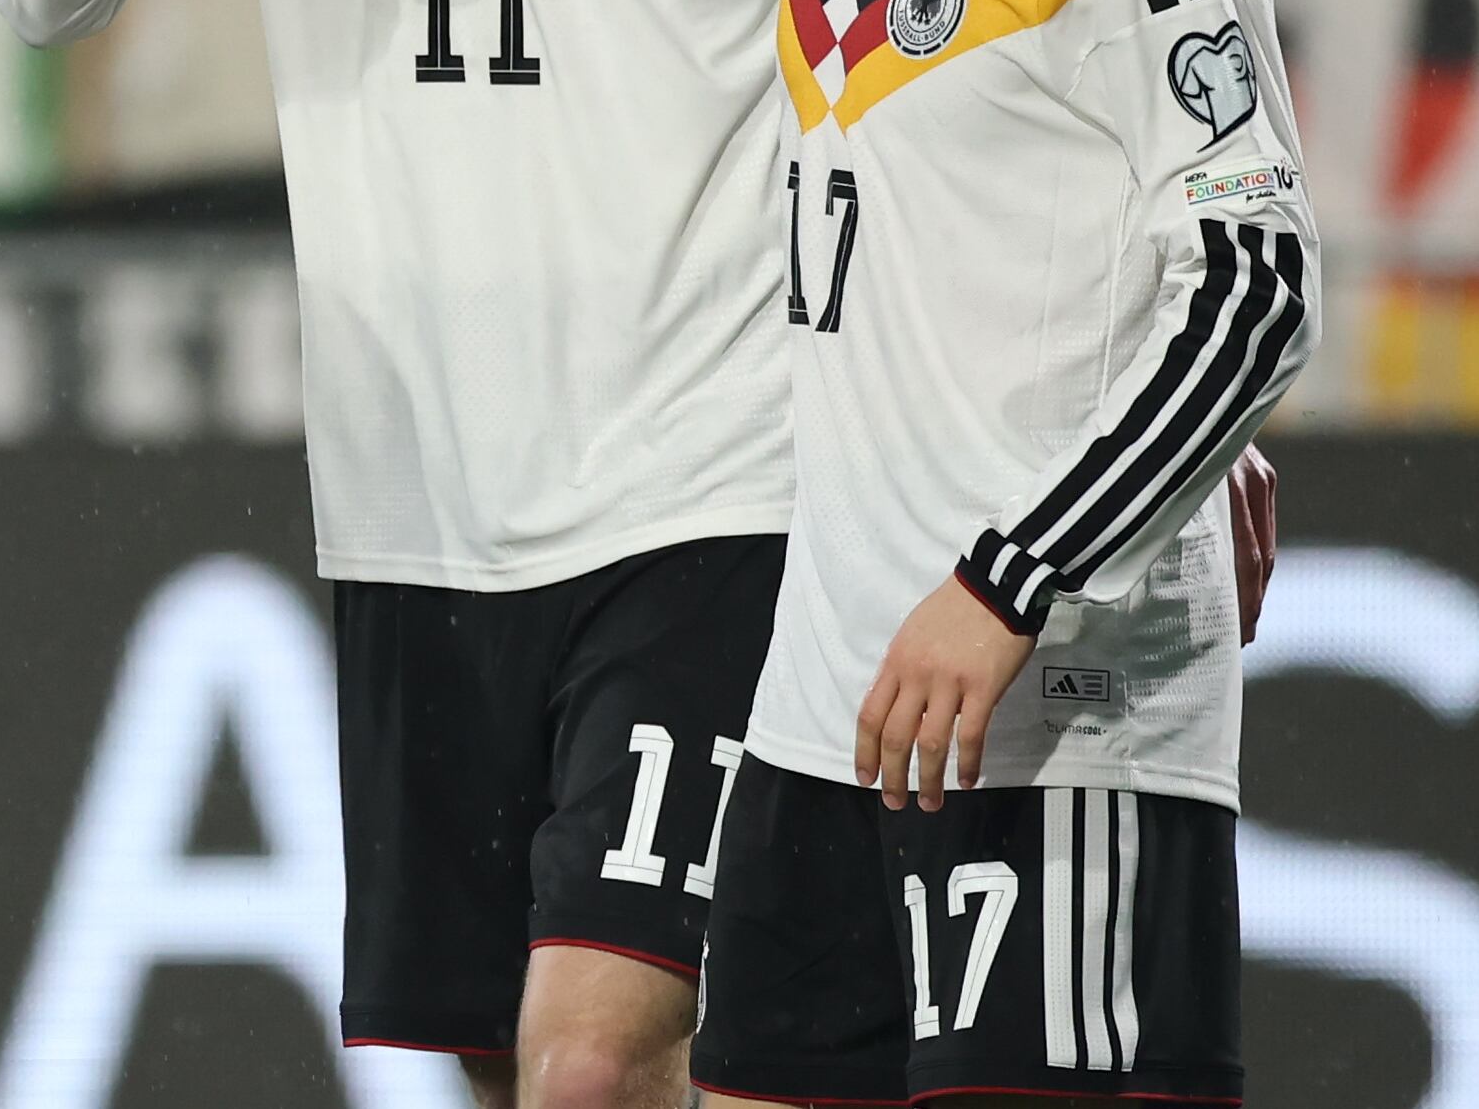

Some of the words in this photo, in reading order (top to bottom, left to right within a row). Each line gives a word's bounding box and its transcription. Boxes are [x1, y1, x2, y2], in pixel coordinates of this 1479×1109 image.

[787, 160, 859, 333] 17
[1186, 172, 1274, 201] FOUNDATION
[904, 861, 1019, 1041] 17
